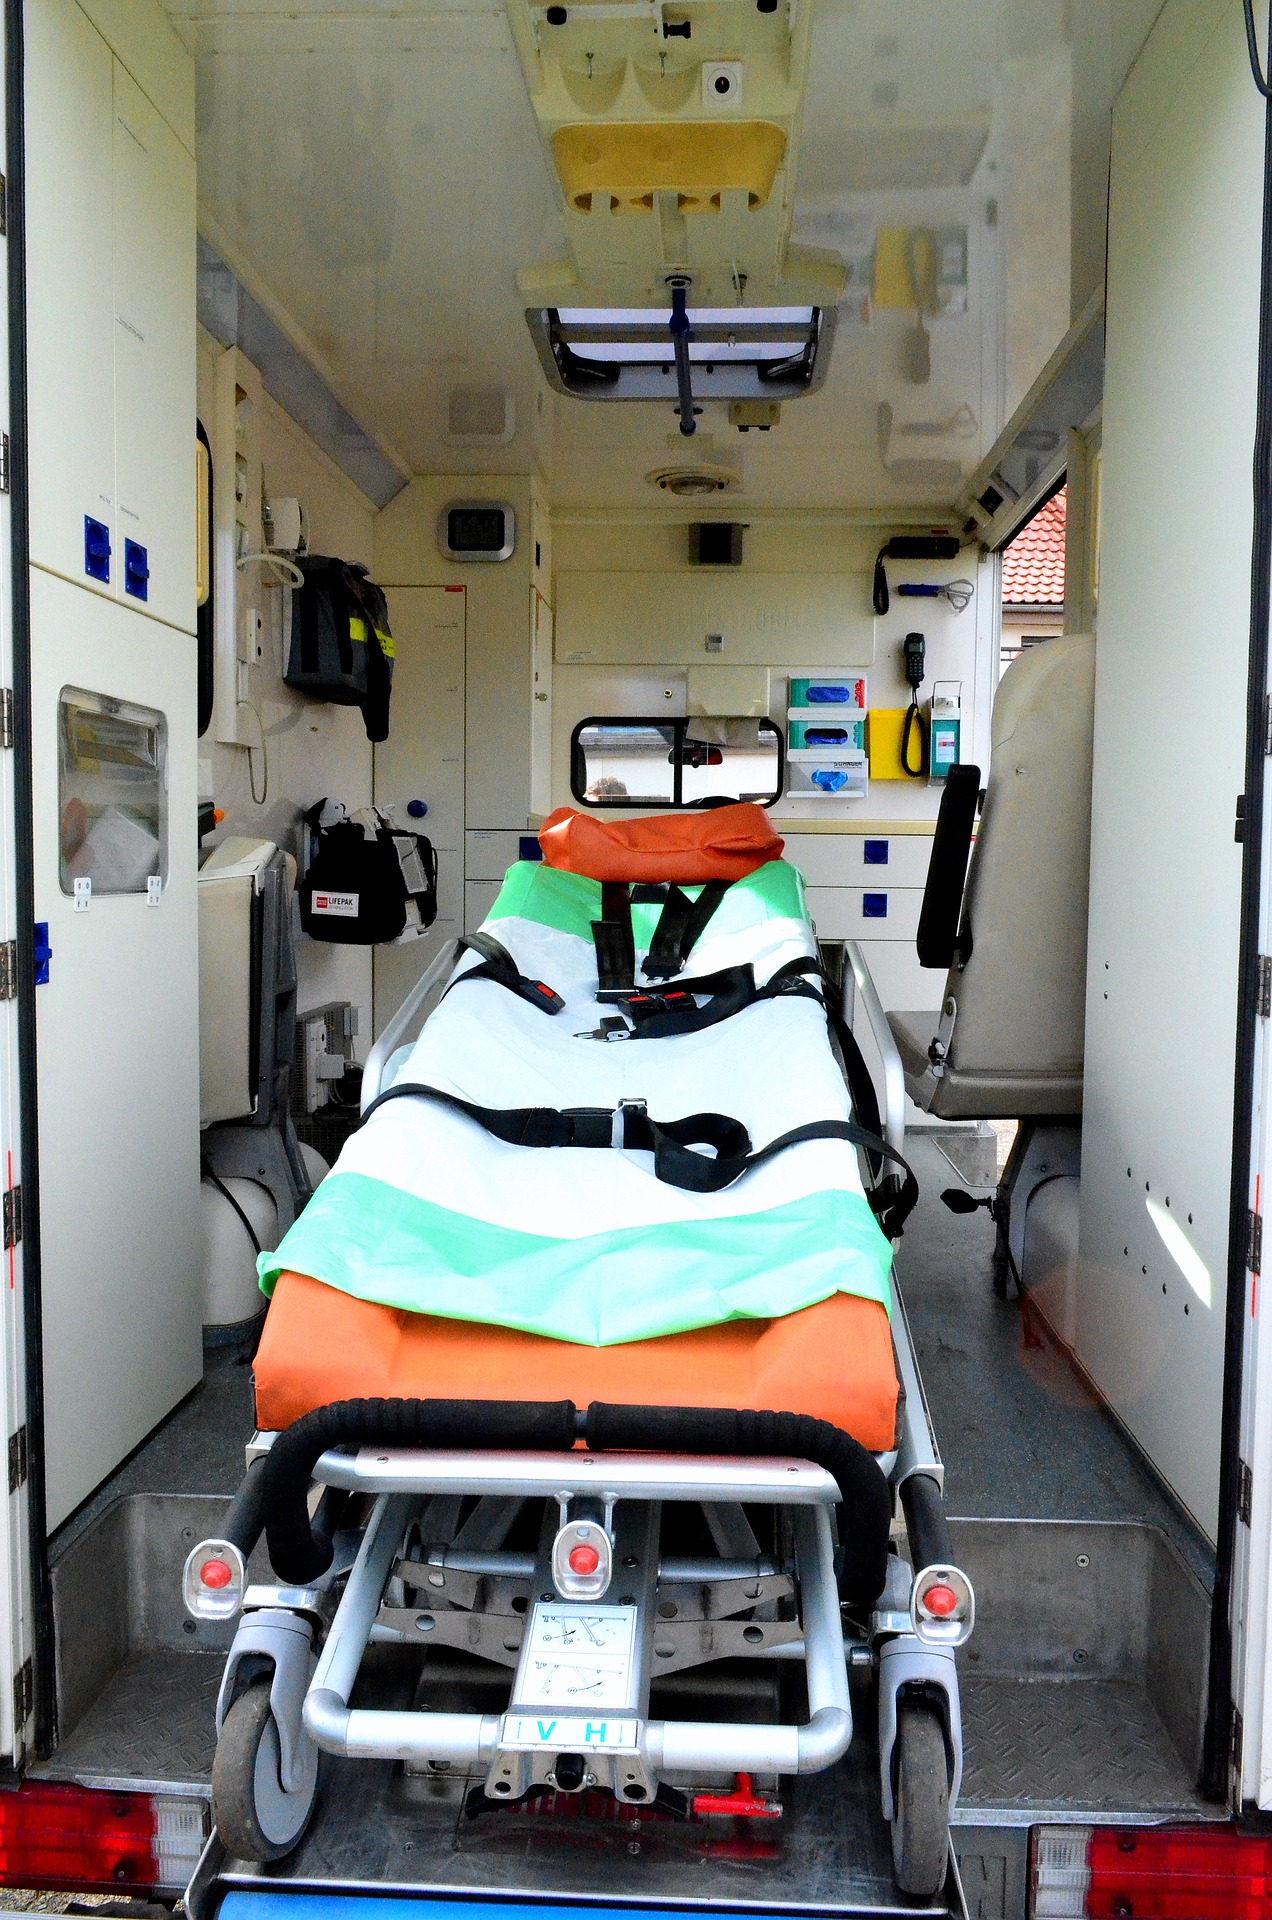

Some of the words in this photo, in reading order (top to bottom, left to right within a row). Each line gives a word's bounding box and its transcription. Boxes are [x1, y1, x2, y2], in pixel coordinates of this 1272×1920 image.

[329, 897, 353, 906] LIFEPAK
[537, 1720, 557, 1741] V
[585, 1722, 606, 1743] H
